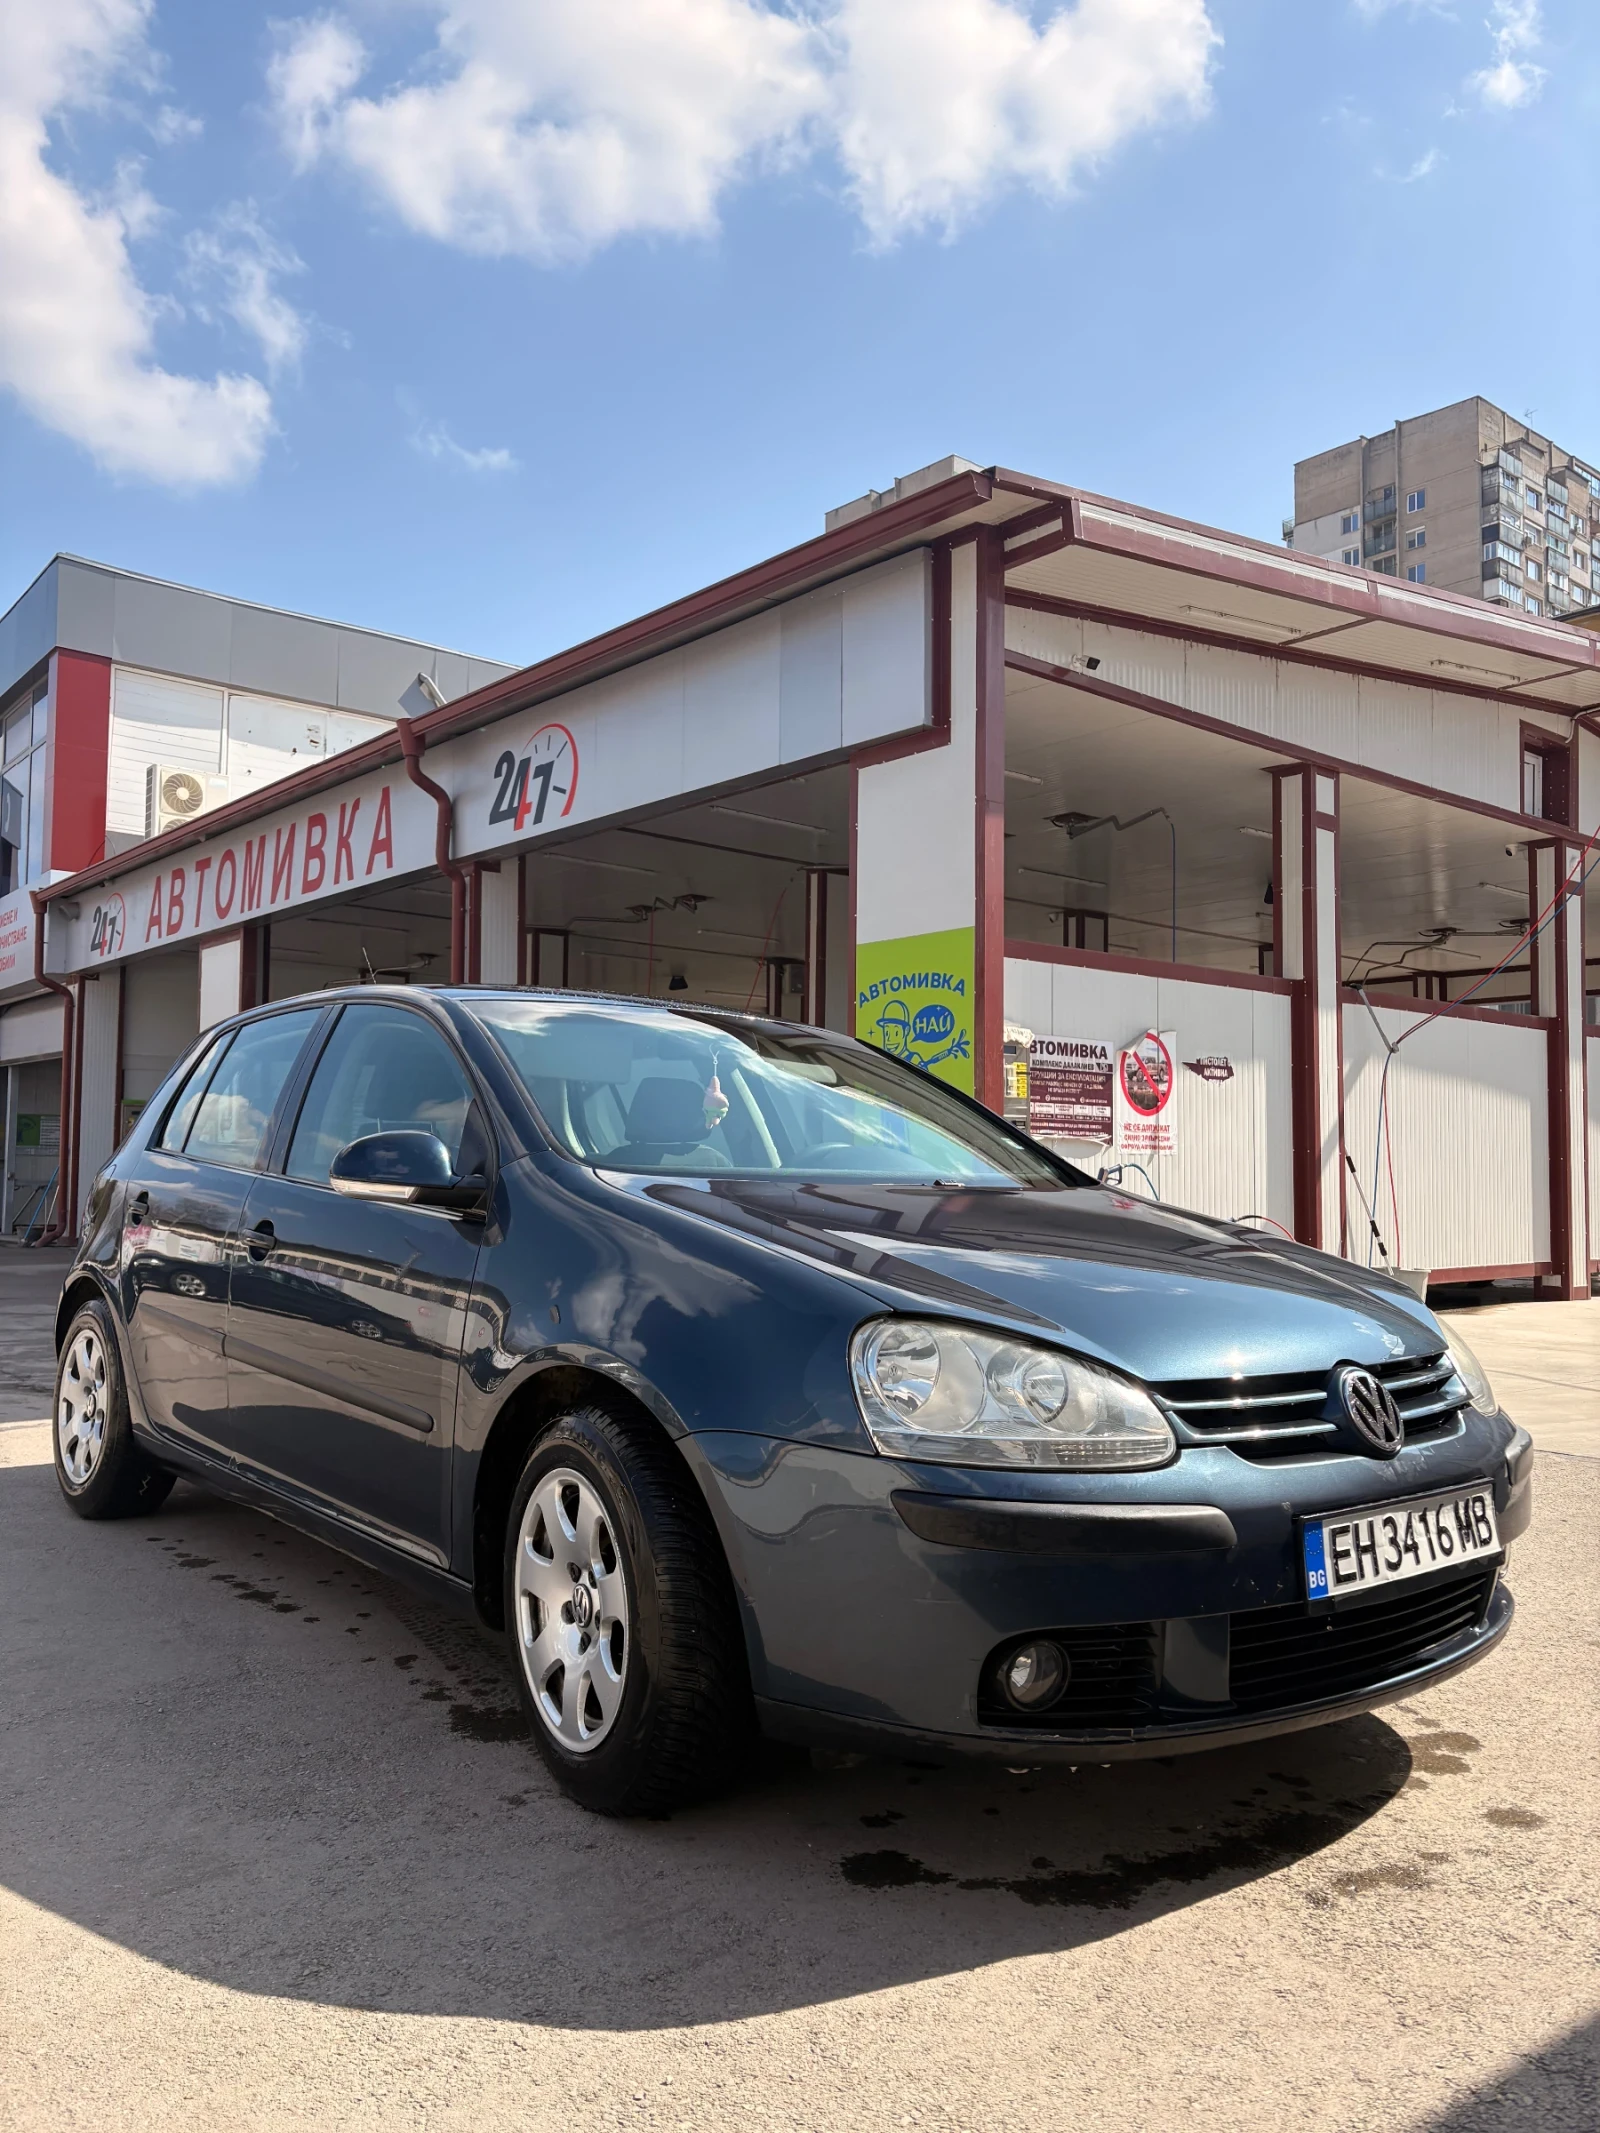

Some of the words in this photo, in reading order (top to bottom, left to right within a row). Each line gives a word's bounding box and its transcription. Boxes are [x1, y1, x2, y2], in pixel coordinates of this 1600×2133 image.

[145, 786, 393, 943] АВТОМИВКА
[859, 972, 965, 1009] АВТОМИВКА
[915, 1011, 951, 1034] НАЙ
[1032, 1059, 1062, 1068] КОМПЛЕКС
[1057, 1072, 1065, 1080] ЗА
[1123, 1122, 1132, 1131] НЕ
[1132, 1123, 1141, 1131] СЕ
[1382, 1504, 1454, 1572] 3416
[1309, 1570, 1326, 1588] BG
